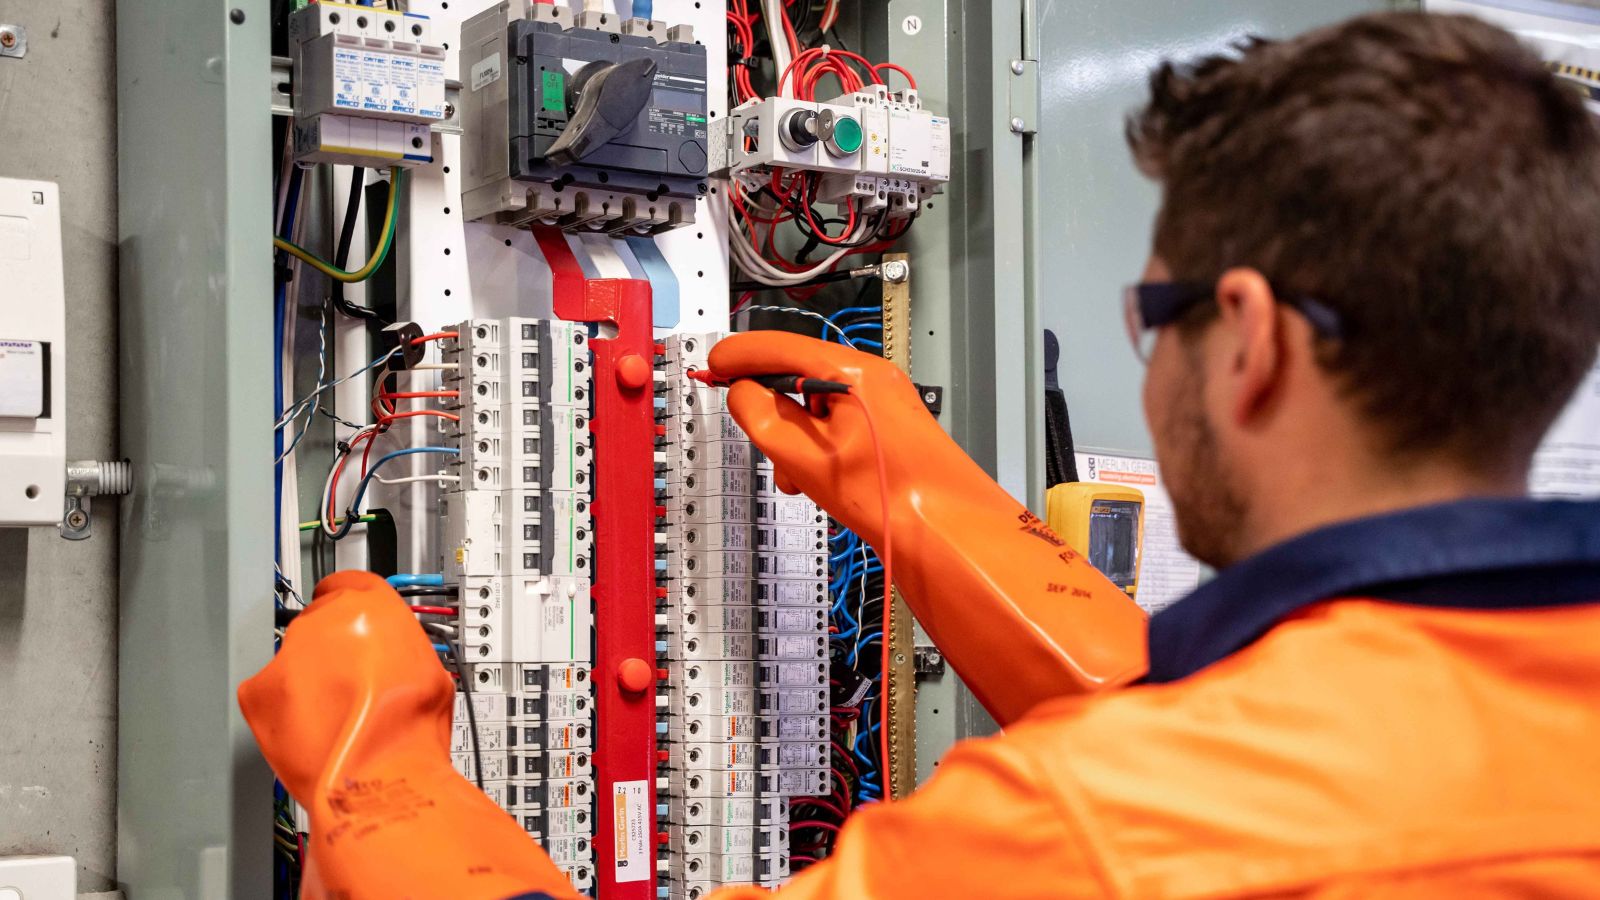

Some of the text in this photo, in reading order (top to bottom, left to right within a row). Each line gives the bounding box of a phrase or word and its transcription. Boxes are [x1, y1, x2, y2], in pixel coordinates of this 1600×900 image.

[907, 19, 917, 30] N
[336, 99, 359, 107] ERICO
[364, 102, 387, 111] ERICO
[392, 105, 415, 113] ERICO
[419, 109, 442, 117] ERICO
[1098, 458, 1129, 472] MERLIN
